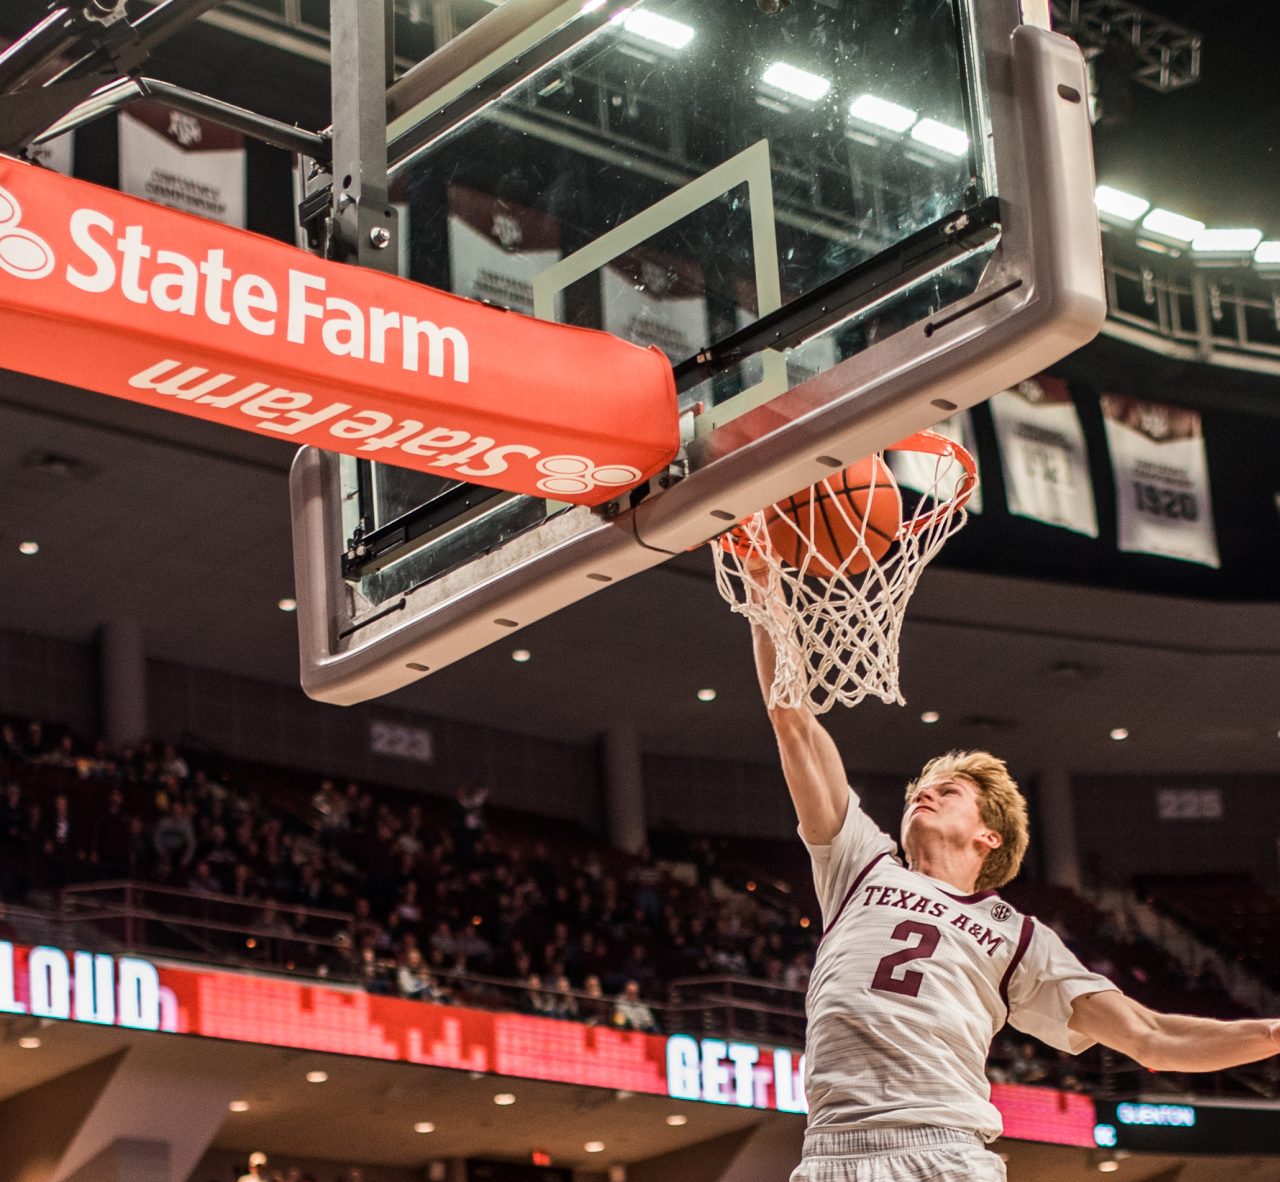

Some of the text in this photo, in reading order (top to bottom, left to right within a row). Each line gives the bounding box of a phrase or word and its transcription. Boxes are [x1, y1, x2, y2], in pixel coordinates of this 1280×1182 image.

[863, 885, 1005, 957] TEXAS A&M
[992, 906, 1011, 919] SEC
[871, 920, 941, 998] 2
[667, 1034, 759, 1108] GET
